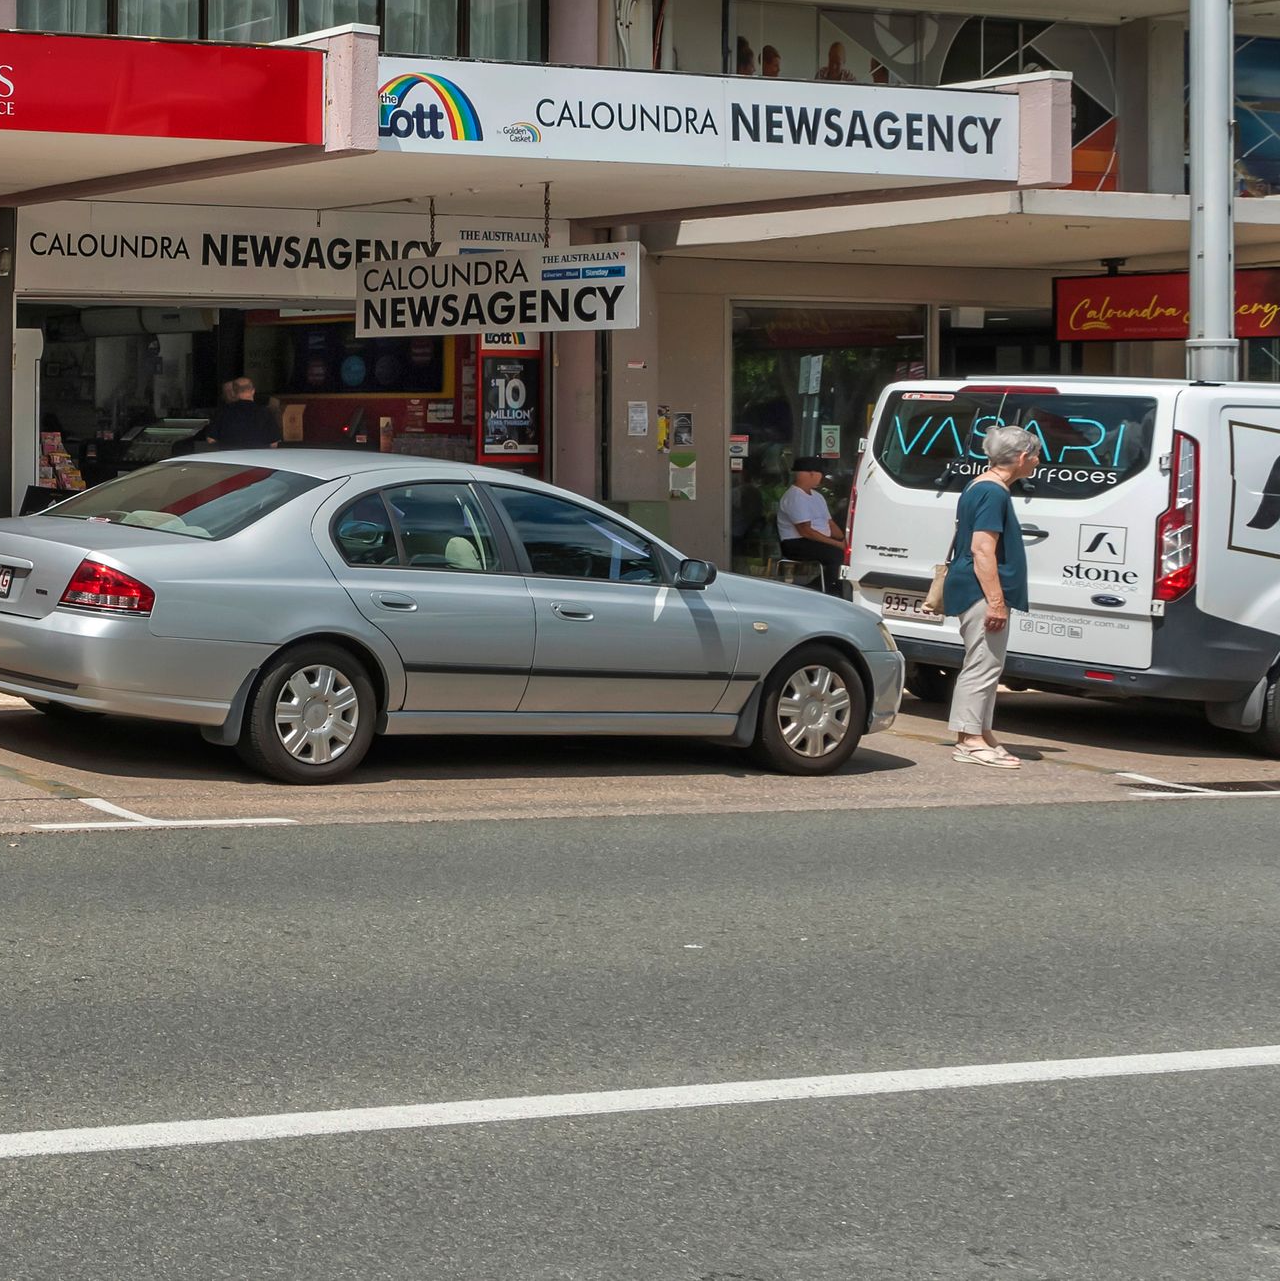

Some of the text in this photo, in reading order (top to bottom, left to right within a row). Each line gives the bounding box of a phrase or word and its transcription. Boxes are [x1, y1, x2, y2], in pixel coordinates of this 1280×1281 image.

[380, 93, 397, 104] the
[503, 126, 527, 134] Golden
[535, 97, 1002, 154] CALOUNDRA NEWSAGENCY
[510, 134, 531, 142] Casket
[459, 230, 546, 243] THE AUSTRALIAN
[29, 231, 190, 260] CALOUNDRA
[542, 252, 619, 264] THE AUSTRALIAN
[363, 259, 529, 292] CALOUNDRA
[585, 269, 609, 277] Sunday
[363, 285, 625, 330] NEWSAGENCY
[1070, 295, 1181, 330] Caloundra
[1028, 468, 1117, 484] urfaces
[865, 544, 909, 553] TRANSIT
[1062, 563, 1139, 585] stone
[1061, 580, 1138, 593] AMBASSADOR
